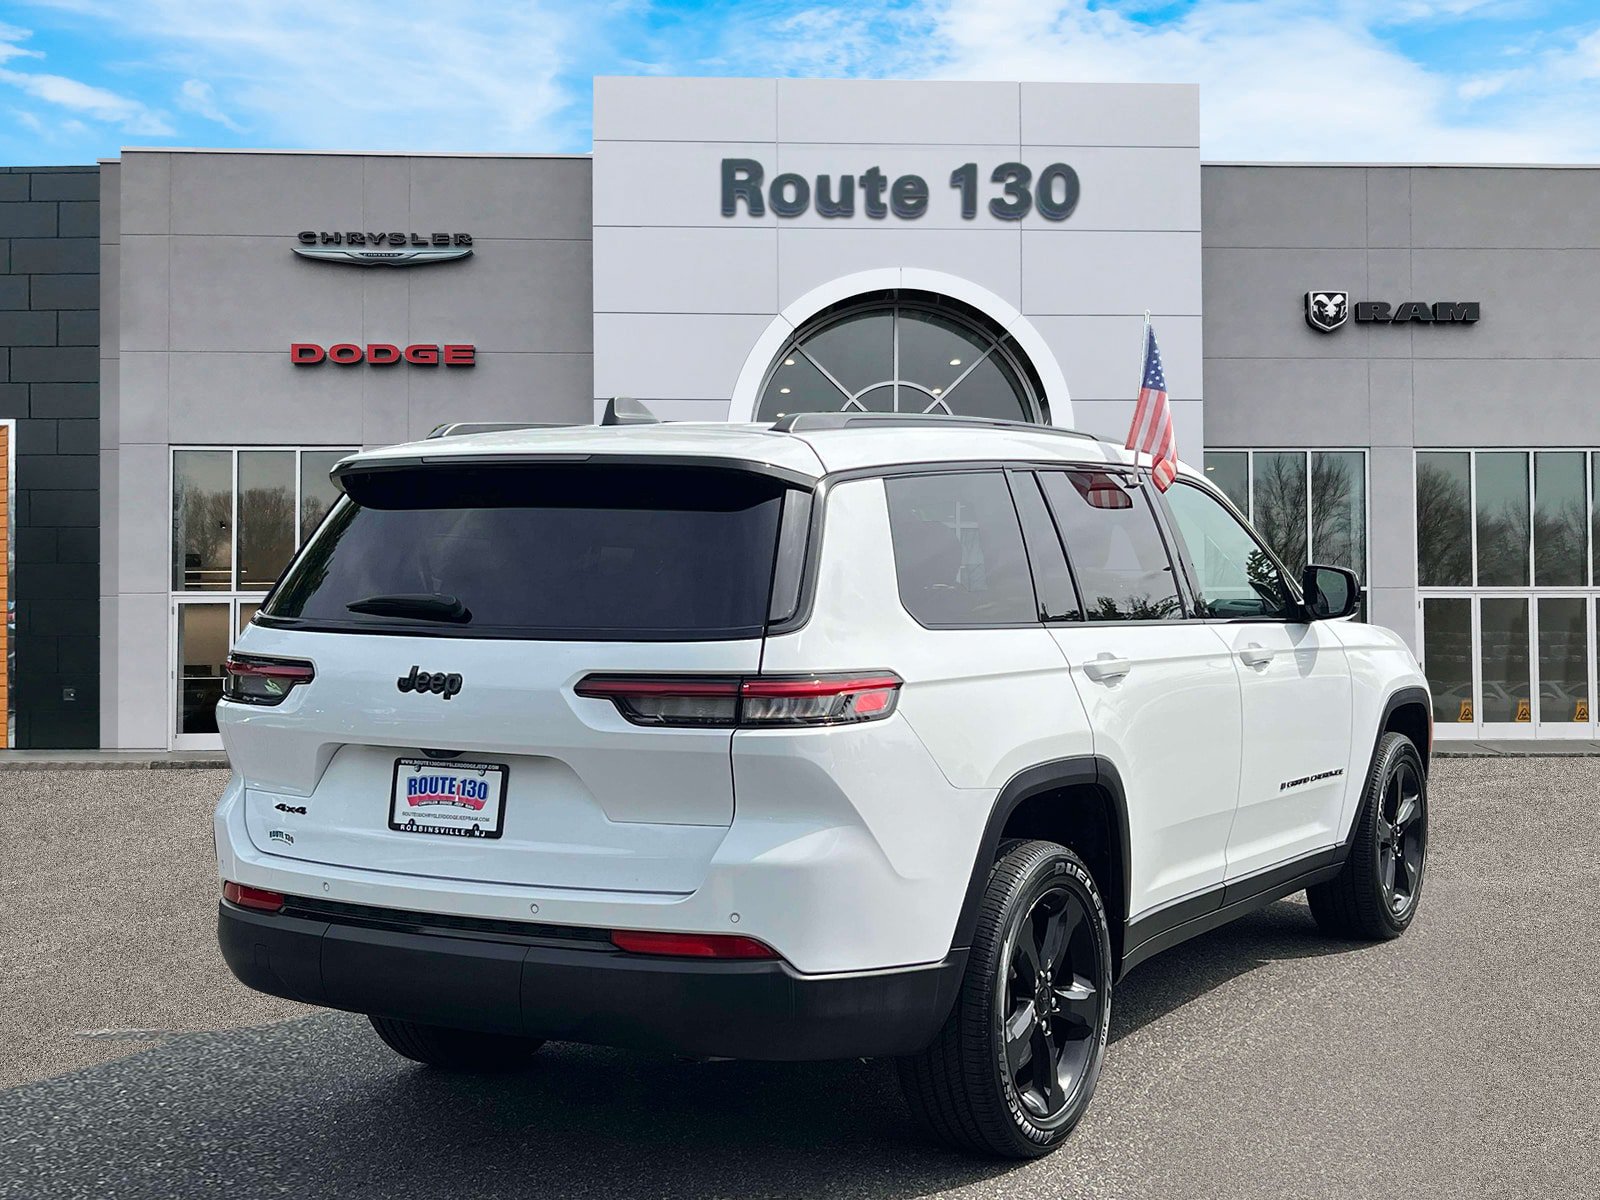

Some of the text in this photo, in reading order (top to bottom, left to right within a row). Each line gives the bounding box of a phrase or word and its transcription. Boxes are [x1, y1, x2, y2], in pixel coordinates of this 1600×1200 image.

[721, 158, 1080, 220] Route 130
[298, 231, 473, 245] CHRYSLER
[1355, 302, 1480, 325] RAM
[291, 343, 475, 366] DODGE
[397, 665, 463, 700] Jeep
[407, 776, 489, 800] ROUTE 130
[400, 824, 470, 837] ROBBINSVILLE,
[1054, 862, 1107, 931] DUELER
